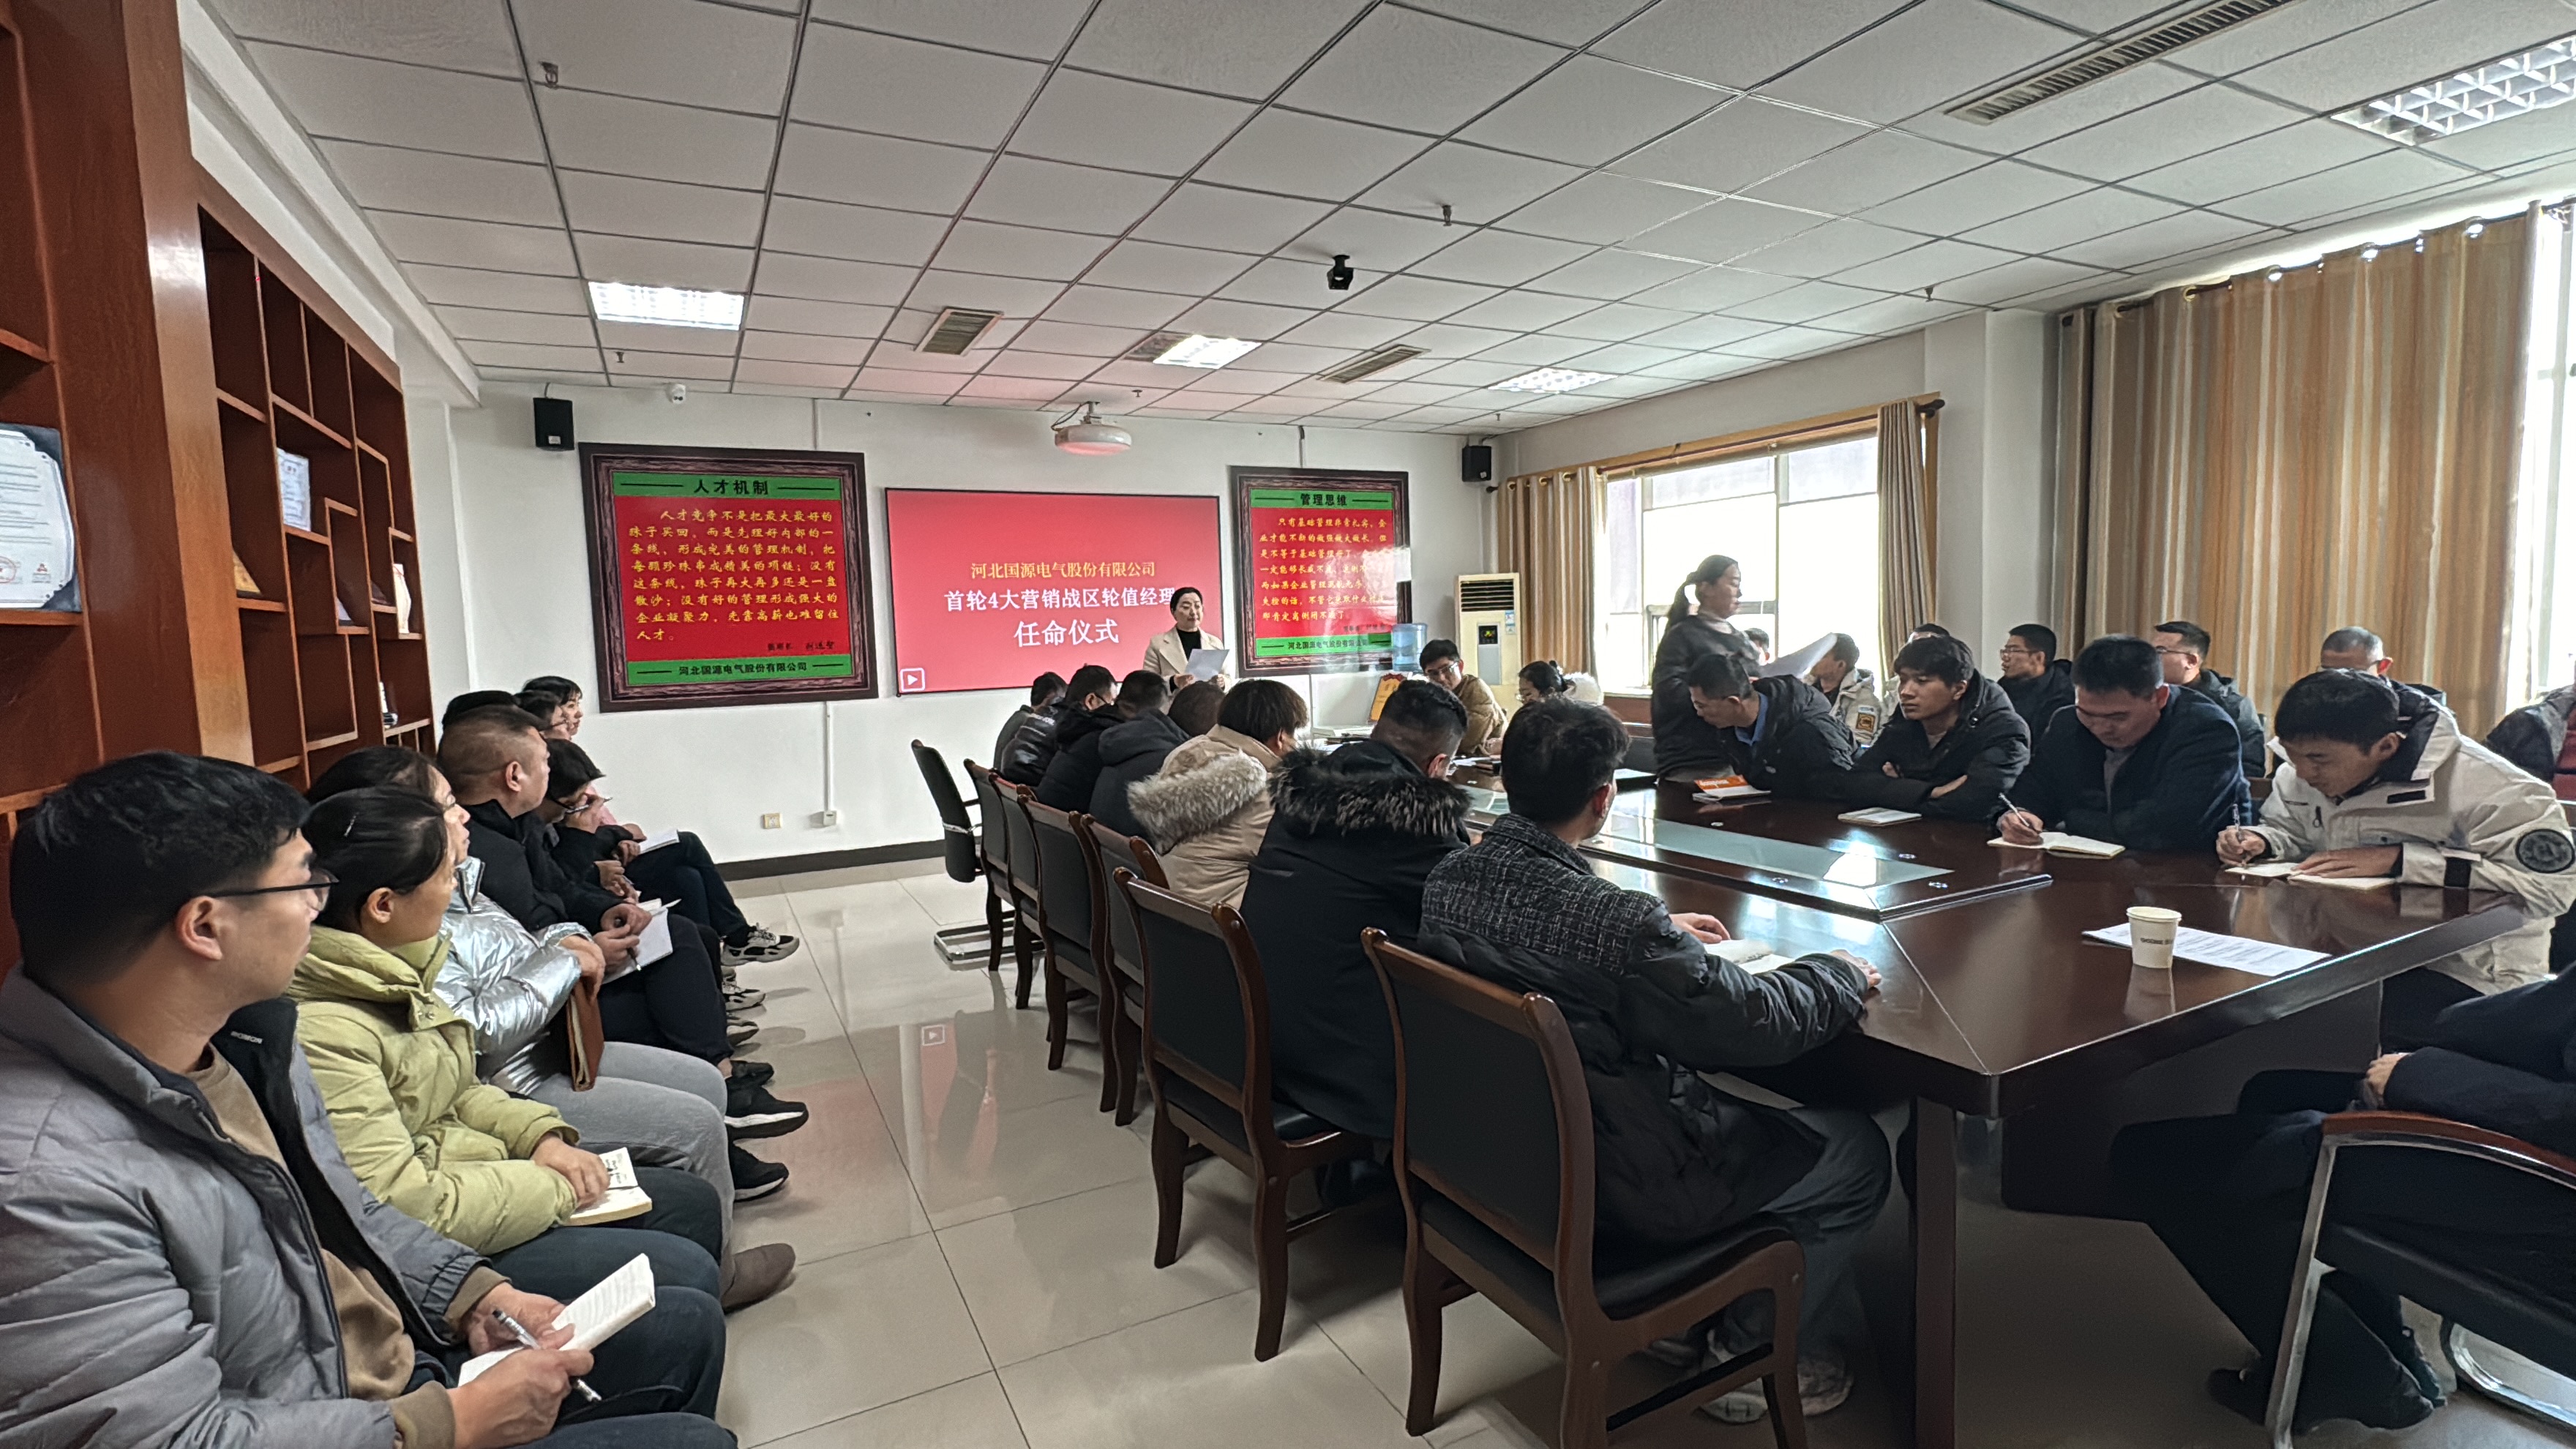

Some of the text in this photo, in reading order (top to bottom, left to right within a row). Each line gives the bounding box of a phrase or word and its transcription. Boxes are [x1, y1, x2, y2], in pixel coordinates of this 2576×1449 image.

[694, 479, 768, 495] 人才机制
[1300, 493, 1347, 506] 管理思维
[661, 509, 833, 523] 人才竞争不是把最大最好的
[971, 562, 1156, 579] 河北国源电气股份有限公司
[945, 587, 1175, 612] 首轮4大营销战区轮值经理
[1014, 618, 1119, 647] 任命仪式
[679, 663, 807, 676] 河北国源电气股份有限公司
